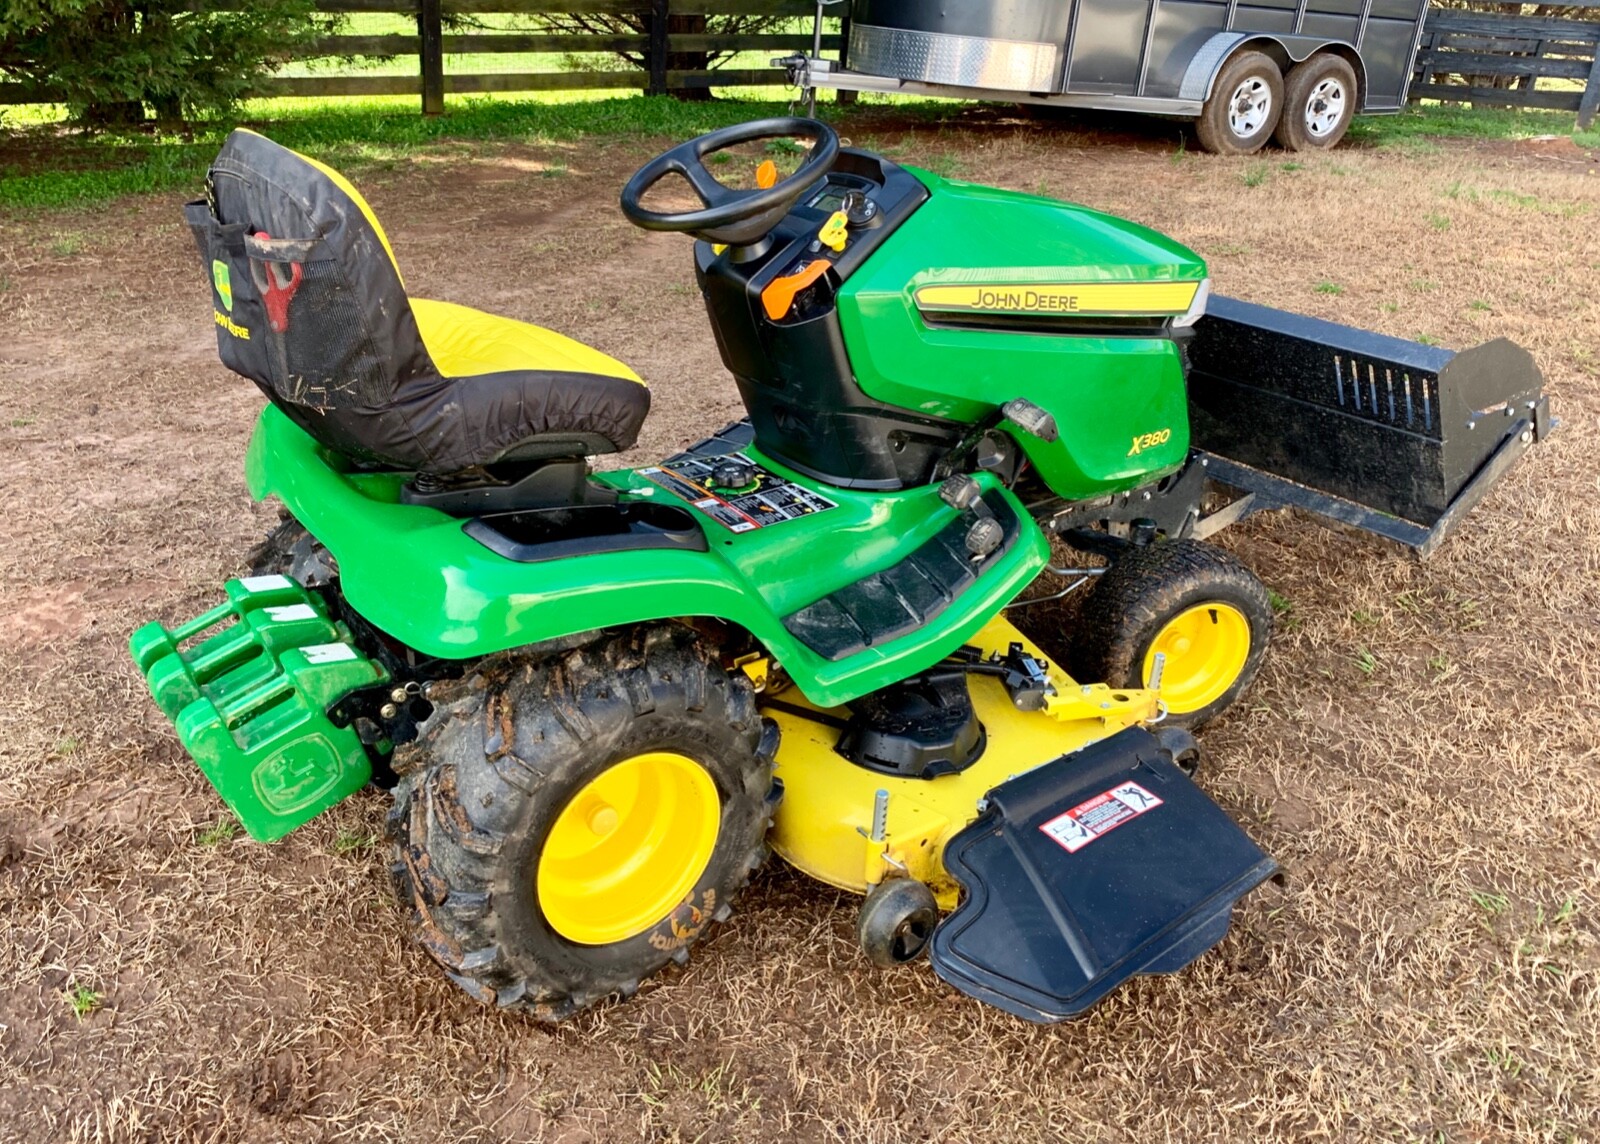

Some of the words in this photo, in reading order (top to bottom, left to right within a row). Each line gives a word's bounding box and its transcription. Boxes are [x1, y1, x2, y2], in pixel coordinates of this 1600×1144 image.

[971, 289, 1021, 307] JOHN
[1025, 291, 1079, 309] DEERE
[1126, 428, 1171, 457] X380
